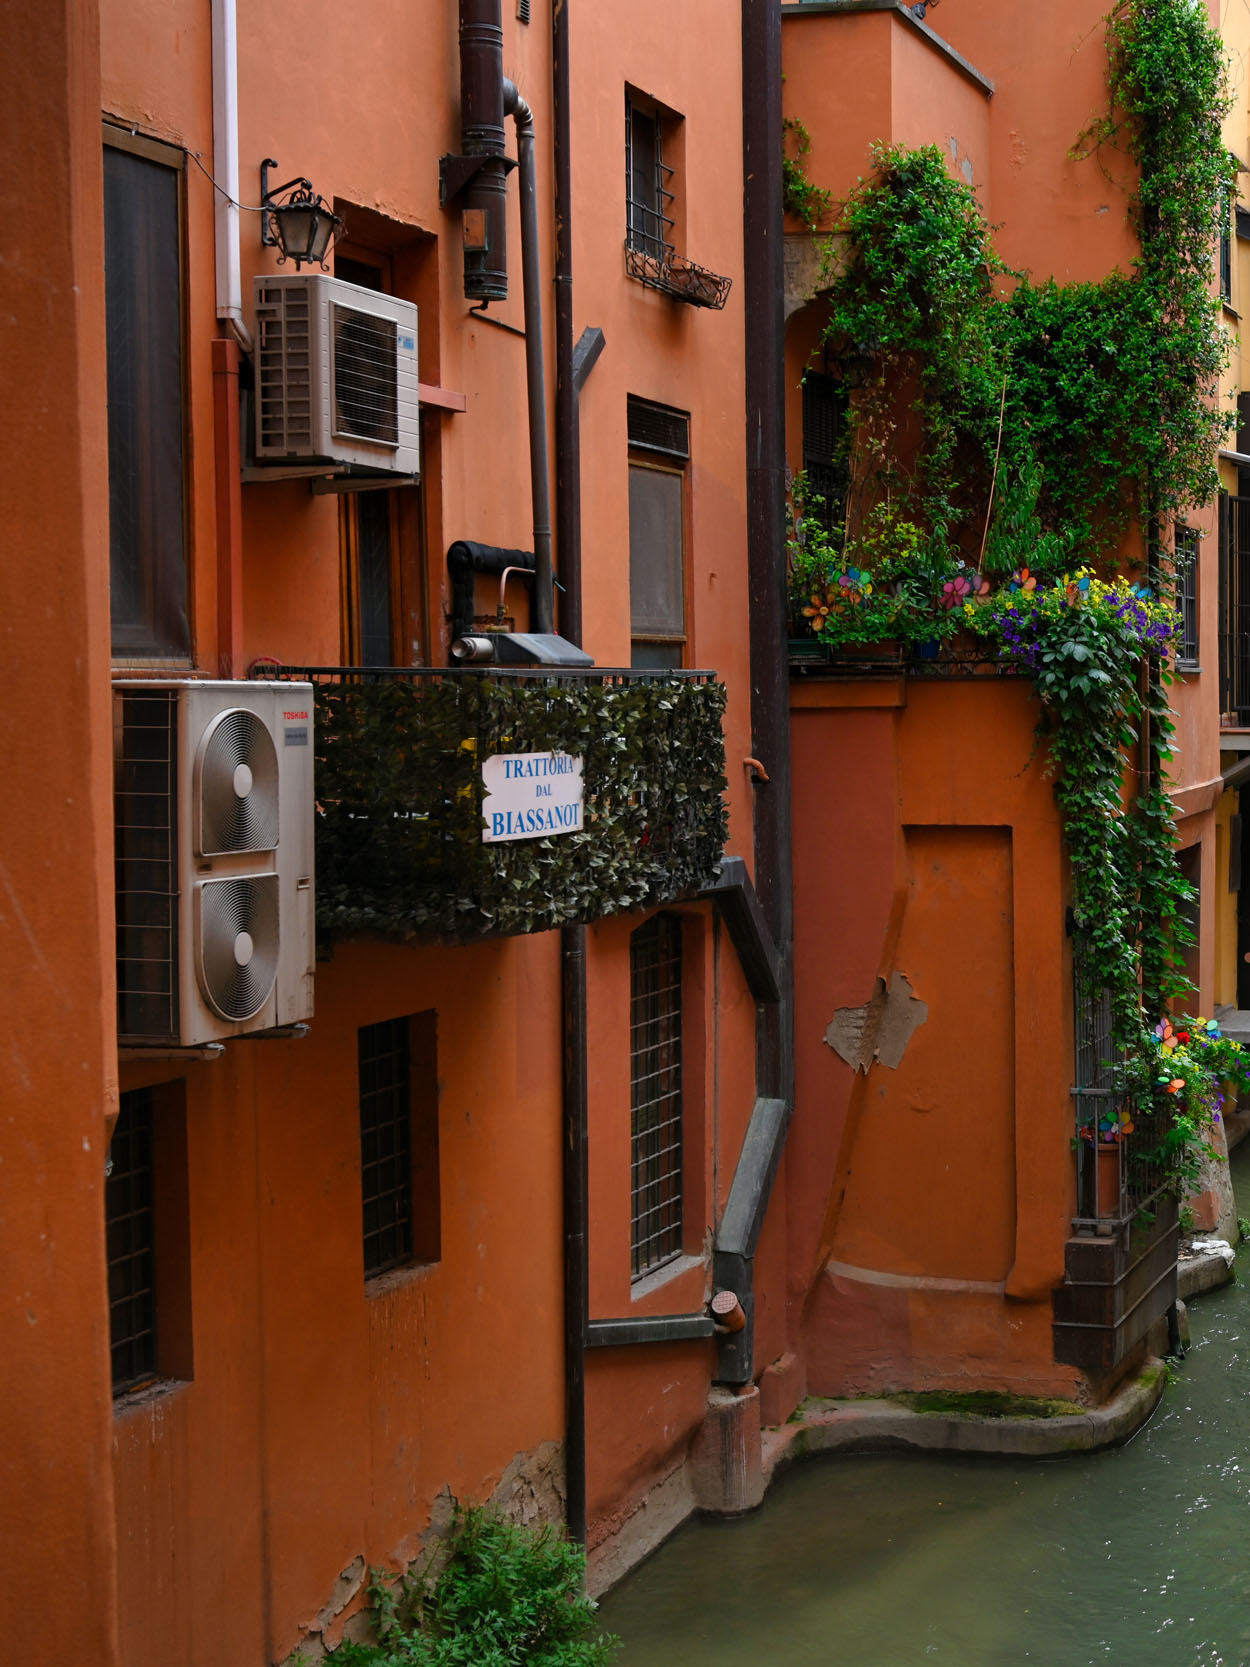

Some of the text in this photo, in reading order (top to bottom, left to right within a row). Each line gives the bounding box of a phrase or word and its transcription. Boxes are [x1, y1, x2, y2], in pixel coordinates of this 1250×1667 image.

[503, 757, 574, 779] TRATTORIA
[535, 784, 552, 797] DAL
[492, 803, 580, 836] BIASSANOT
